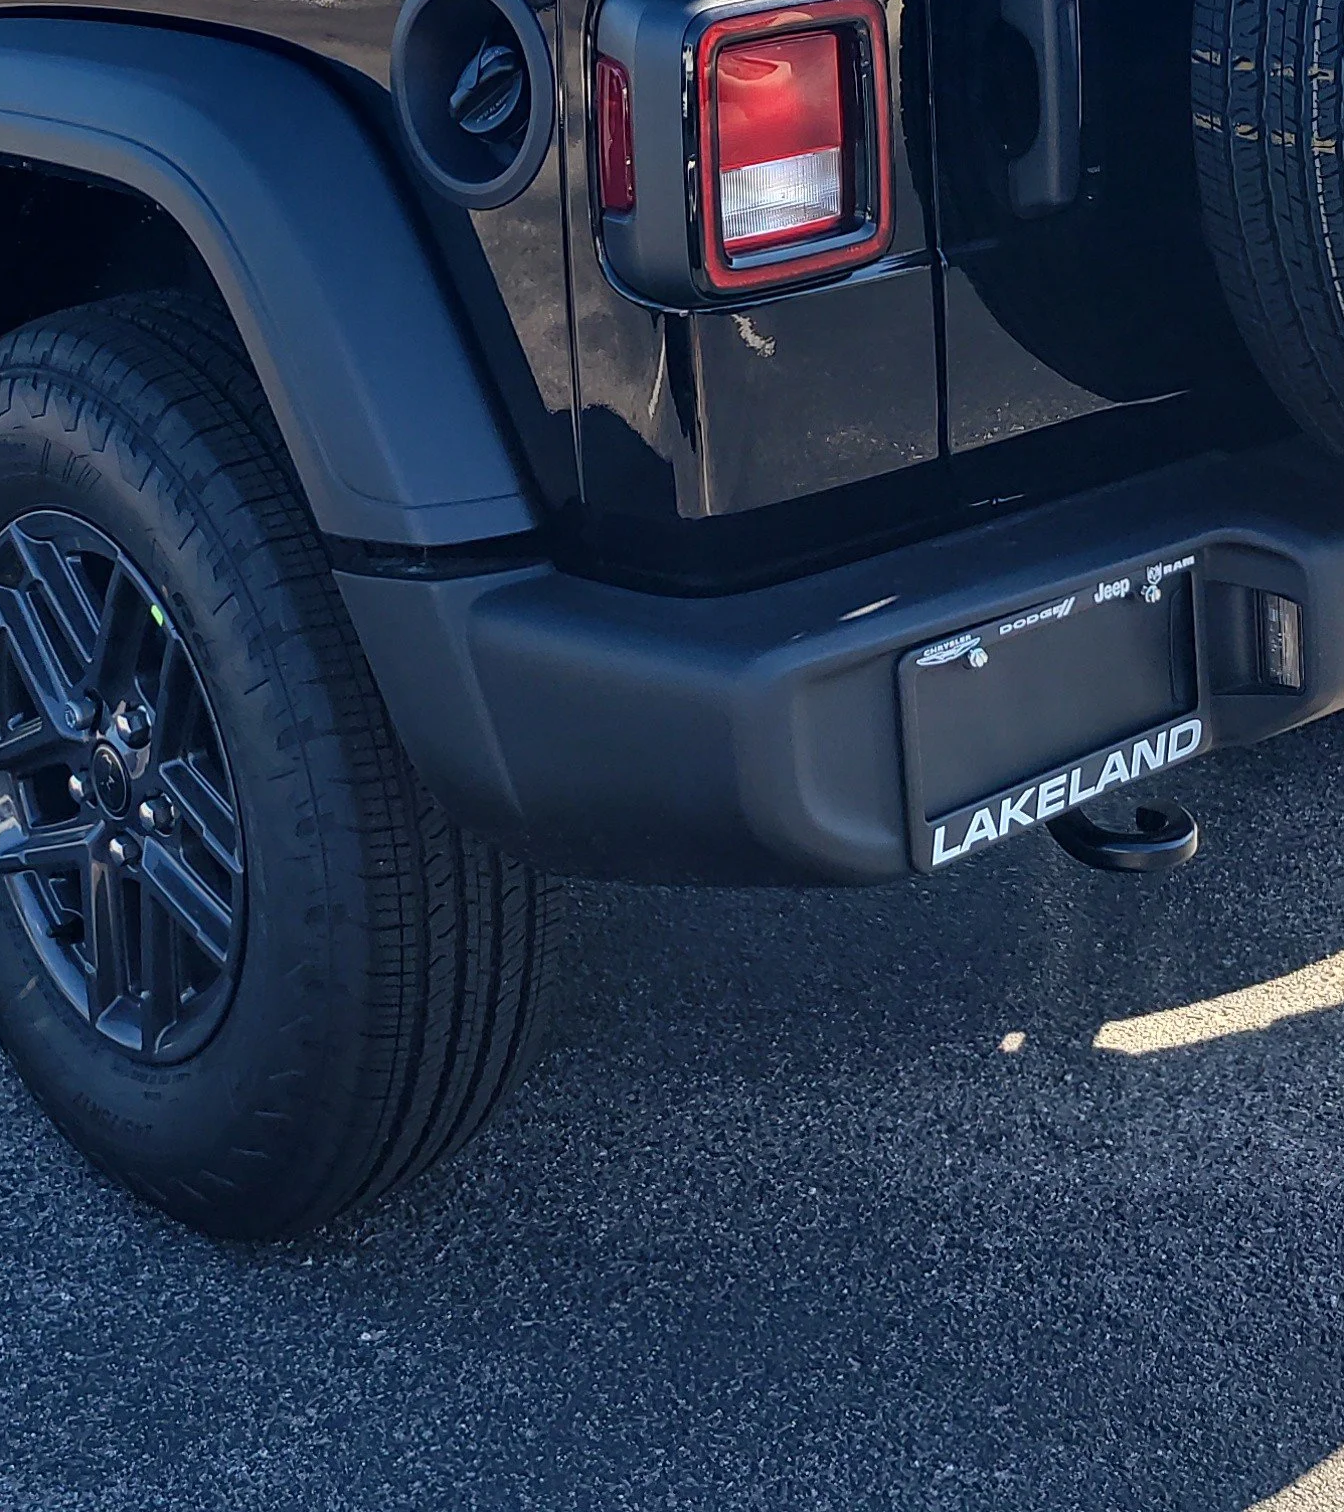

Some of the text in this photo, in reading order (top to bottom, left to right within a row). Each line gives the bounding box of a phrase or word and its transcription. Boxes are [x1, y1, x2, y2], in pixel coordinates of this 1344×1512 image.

[1163, 555, 1195, 575] RAM
[1094, 577, 1131, 604] Jeep
[923, 633, 972, 657] CHRYSLER
[931, 719, 1203, 865] LAKELAND
